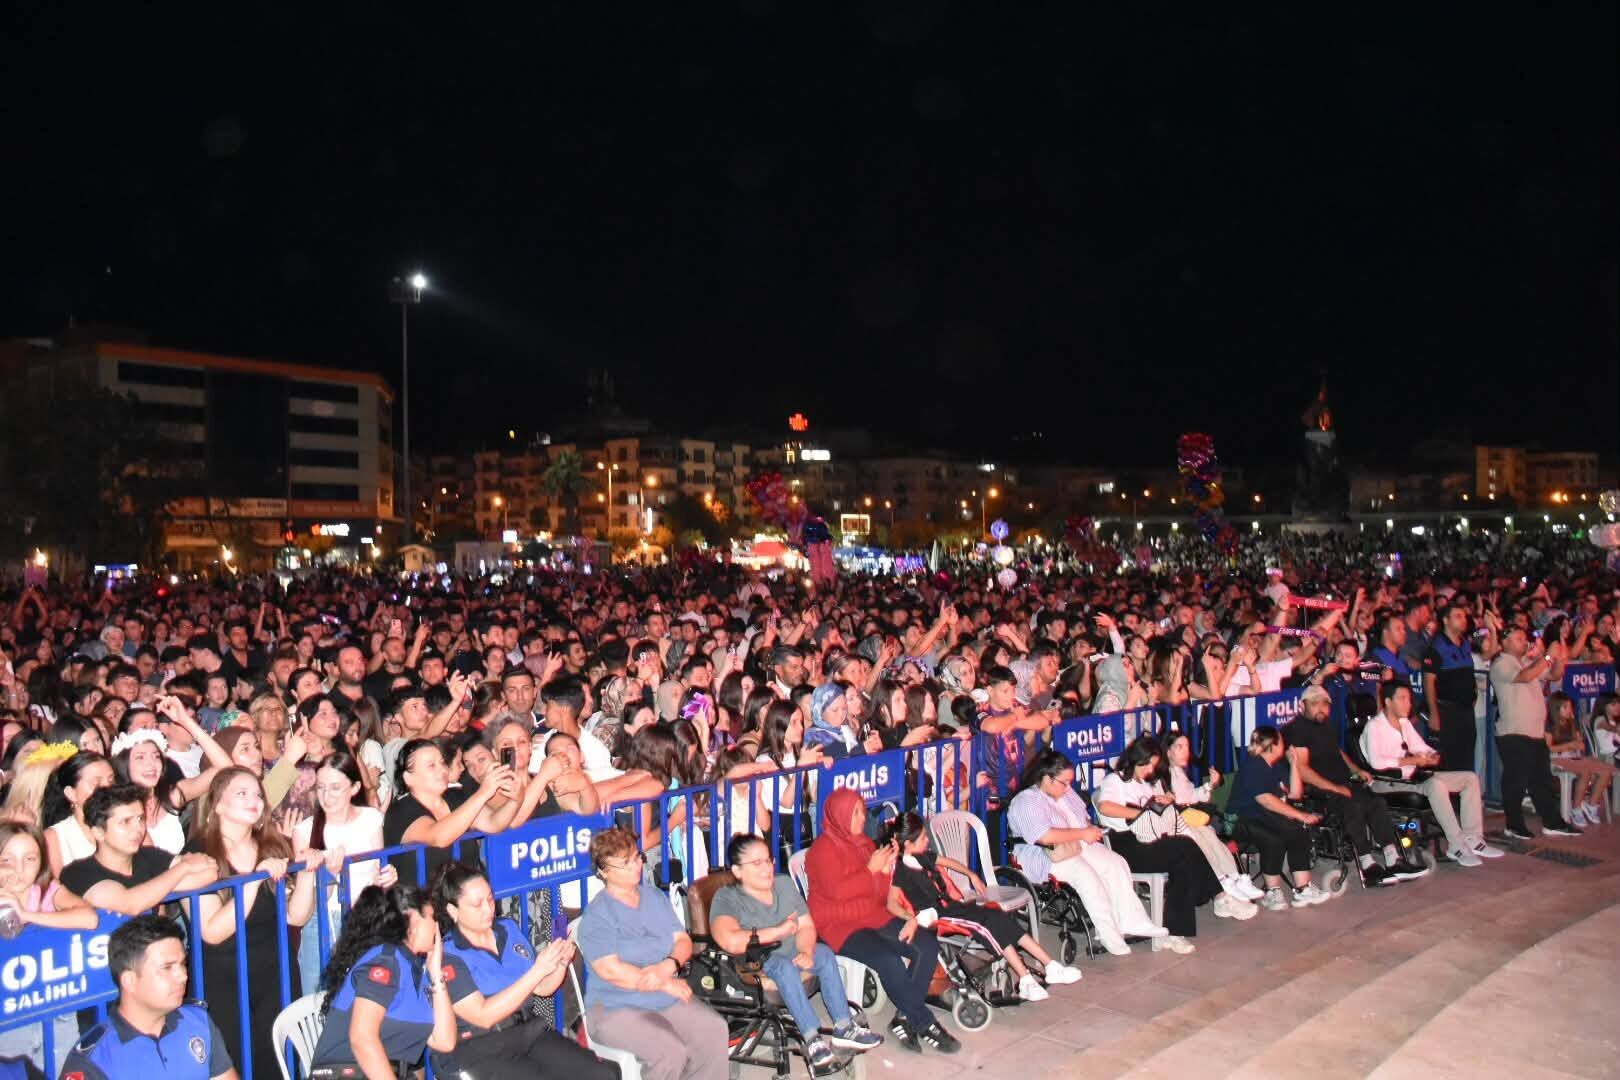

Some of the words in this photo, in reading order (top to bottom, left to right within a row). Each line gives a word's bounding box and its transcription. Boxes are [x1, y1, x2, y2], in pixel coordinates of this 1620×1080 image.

[1573, 671, 1606, 688] POLİS
[1067, 723, 1112, 749] POLİS
[833, 763, 888, 791] POLİS
[511, 826, 591, 869] POLİS
[531, 856, 577, 879] SALİHLİ
[0, 933, 110, 991] OLİS
[4, 974, 87, 1015] SALİHLİ
